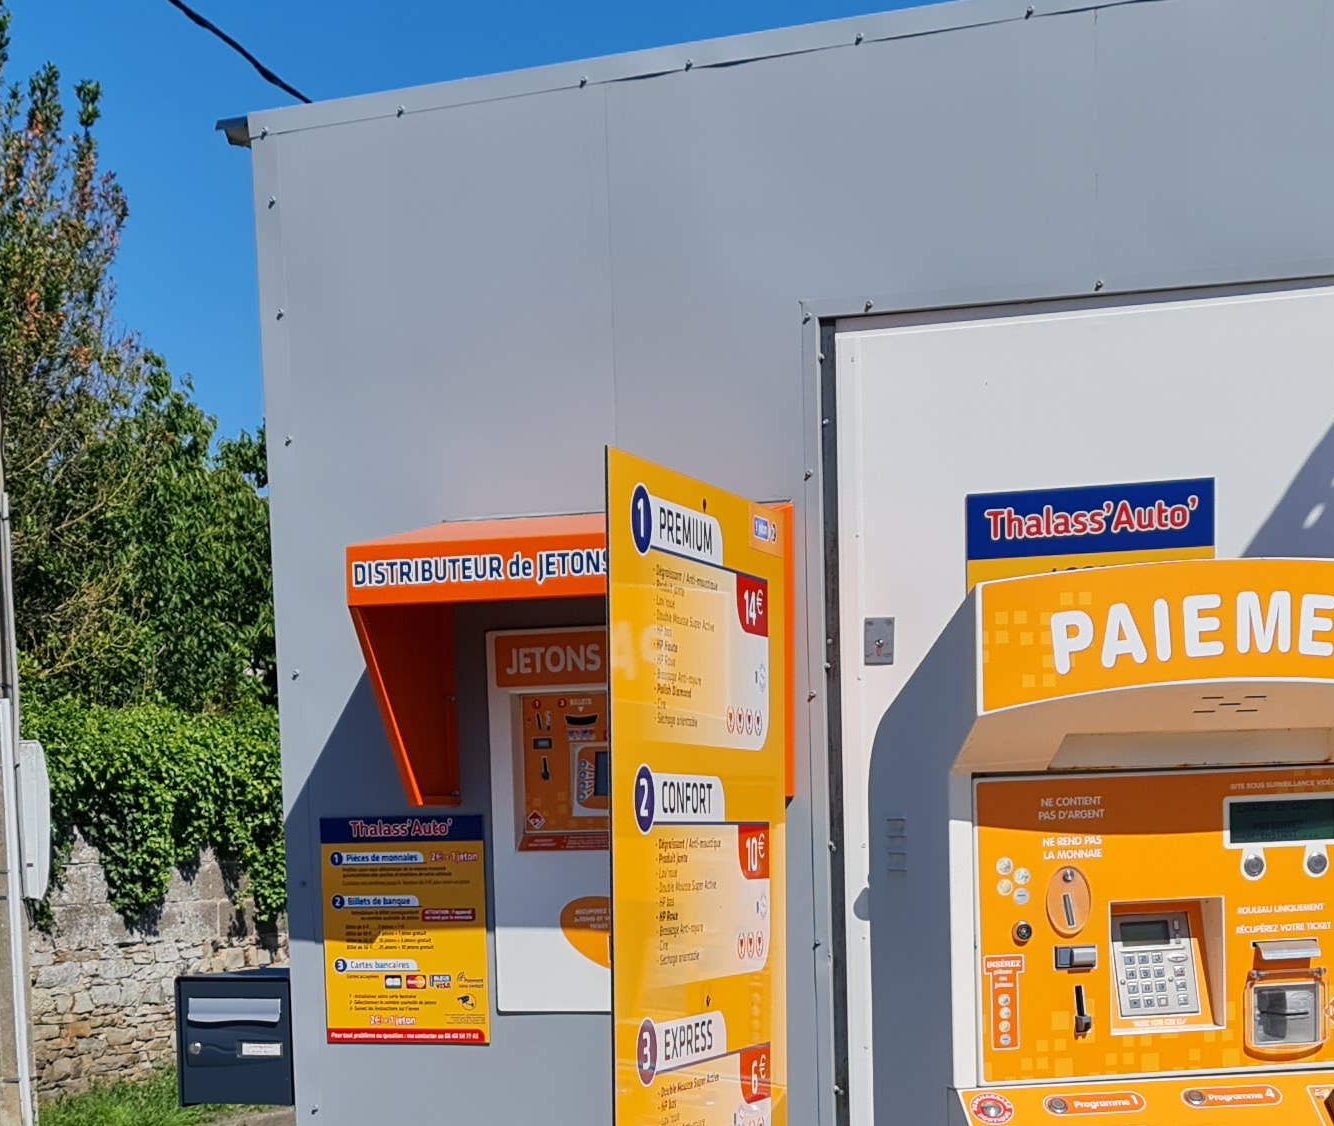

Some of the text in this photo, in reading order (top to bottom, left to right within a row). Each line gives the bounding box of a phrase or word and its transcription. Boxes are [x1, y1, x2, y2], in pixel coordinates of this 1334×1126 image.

[985, 496, 1199, 541] Thalass'Auto'
[637, 497, 645, 540] 1
[659, 506, 713, 556] PREMIUM
[354, 556, 502, 585] DISTRIBUTEUR
[509, 553, 532, 577] de
[744, 589, 763, 626] 14€
[506, 644, 601, 675] JETONS
[1230, 782, 1245, 790] SITE
[1246, 781, 1265, 789] SOUS
[1266, 780, 1316, 788] SURVEILLANCE
[639, 777, 712, 817] 2 CONFORT
[1041, 796, 1102, 807] NE CONTIENT
[1038, 809, 1105, 820] PAS D'ARGENT
[349, 819, 453, 837] Thalass'Auto'
[1042, 835, 1102, 847] NE REND PAS
[346, 853, 370, 862] Pièces
[371, 853, 380, 862] de
[746, 832, 765, 871] 10€
[1043, 849, 1102, 860] LA MONNAIE
[348, 898, 371, 906] Billets
[373, 898, 381, 906] de
[383, 898, 411, 908] banque
[1238, 902, 1324, 914] ROULEAU UNIQUEMENT
[1236, 921, 1331, 934] RÉCUPÉREZ VOTRE TICKET
[350, 961, 373, 969] Cartes
[375, 960, 410, 969] bancaires
[643, 1019, 713, 1070] 3 EXPRESS
[751, 1054, 766, 1095] 6€
[1073, 1095, 1139, 1109] Programme 1
[1207, 1088, 1275, 1103] Programme 4
